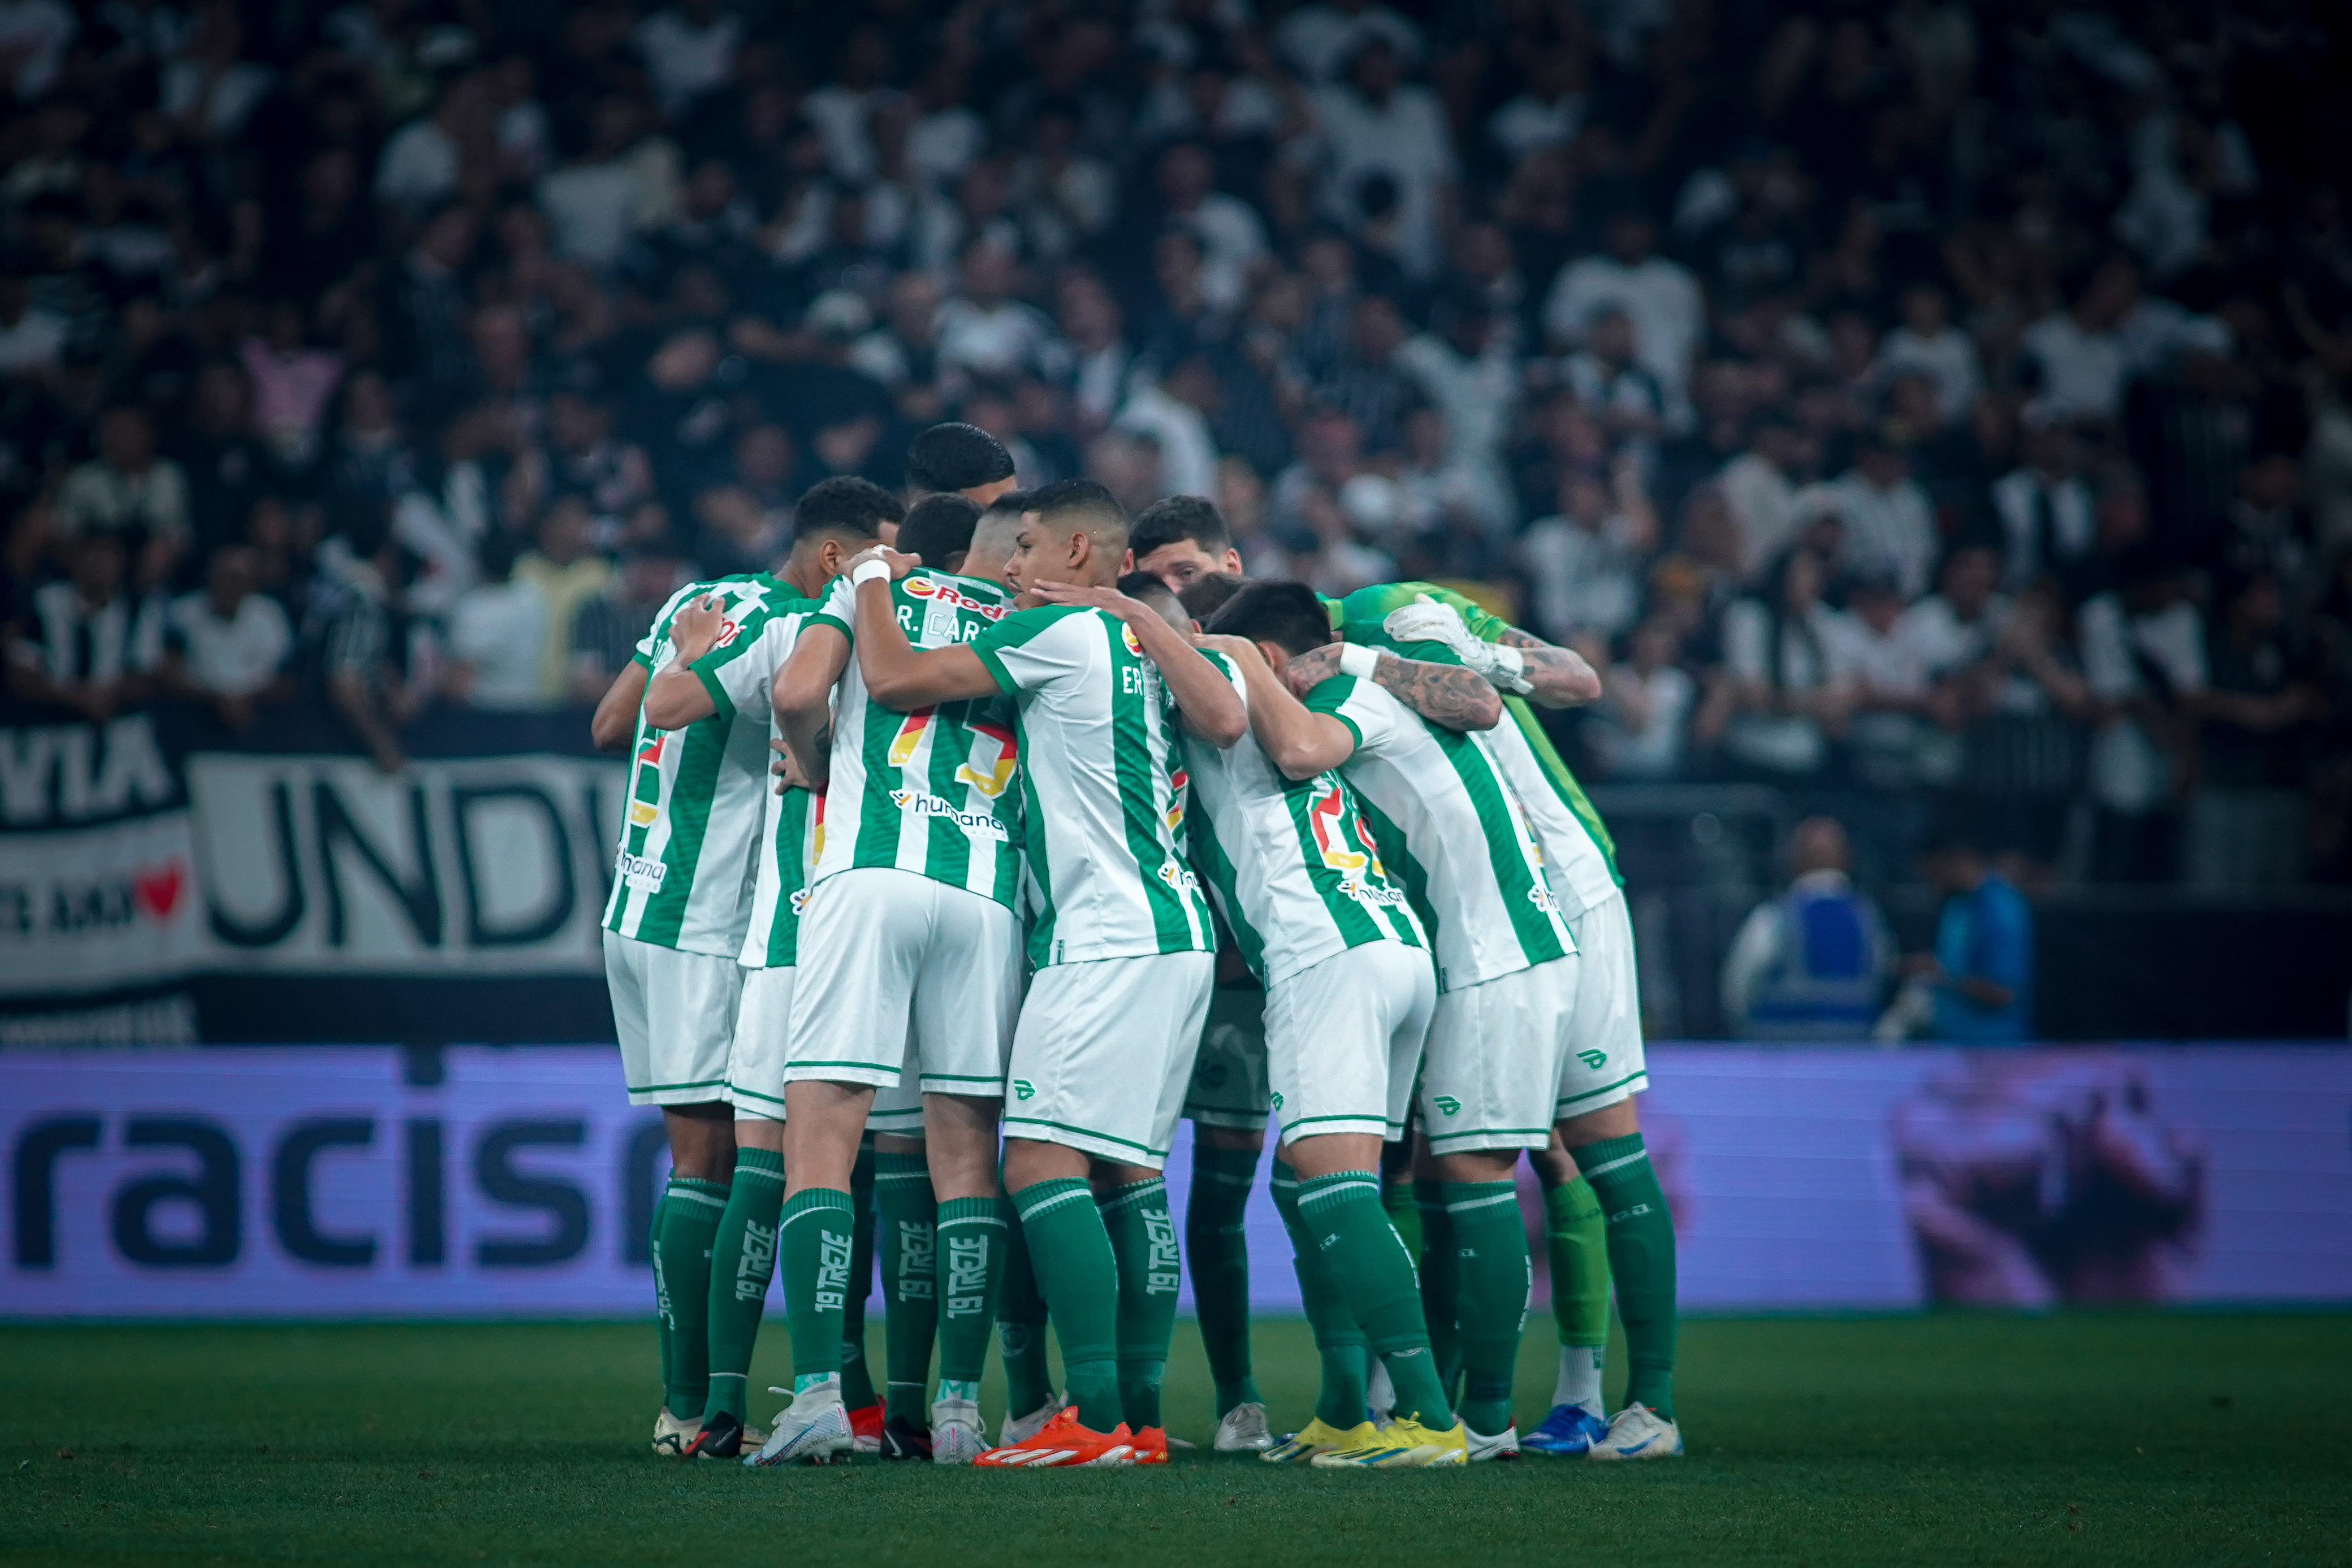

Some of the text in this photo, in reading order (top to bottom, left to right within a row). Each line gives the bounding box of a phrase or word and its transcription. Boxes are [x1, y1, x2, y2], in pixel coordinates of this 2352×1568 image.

[928, 612, 988, 643] CAR
[915, 793, 1005, 831] humana
[14, 1046, 670, 1267] racis
